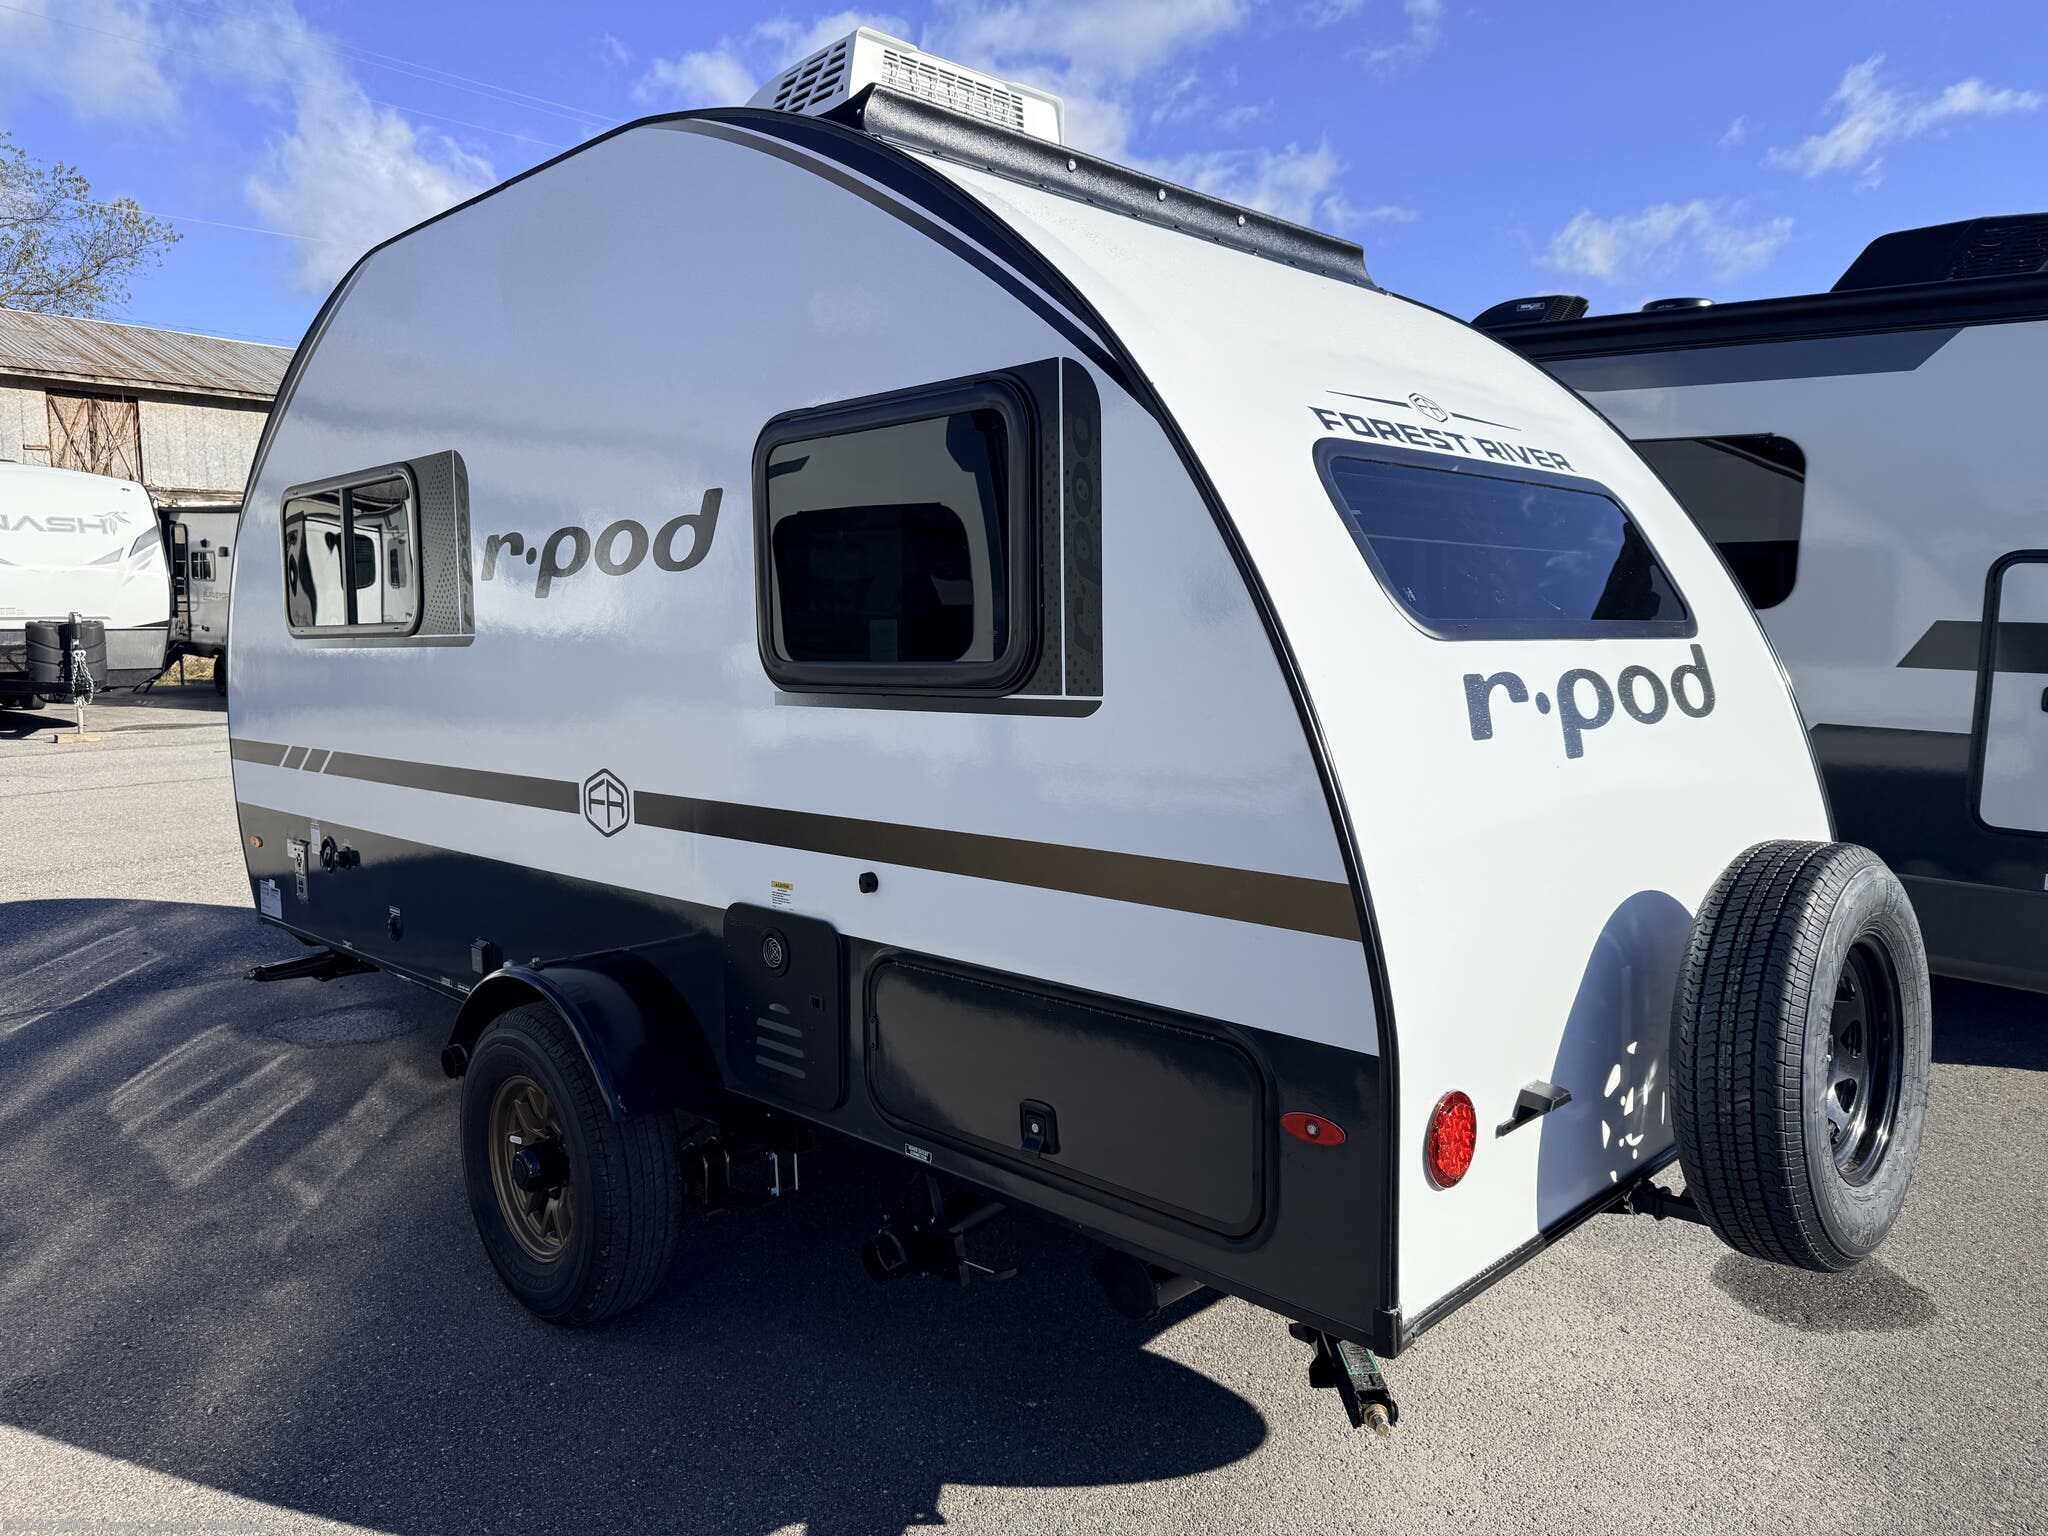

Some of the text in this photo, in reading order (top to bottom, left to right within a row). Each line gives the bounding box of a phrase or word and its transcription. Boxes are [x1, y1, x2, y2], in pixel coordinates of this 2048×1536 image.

[1306, 405, 1577, 473] FOREST RIVER
[0, 513, 109, 535] ASH
